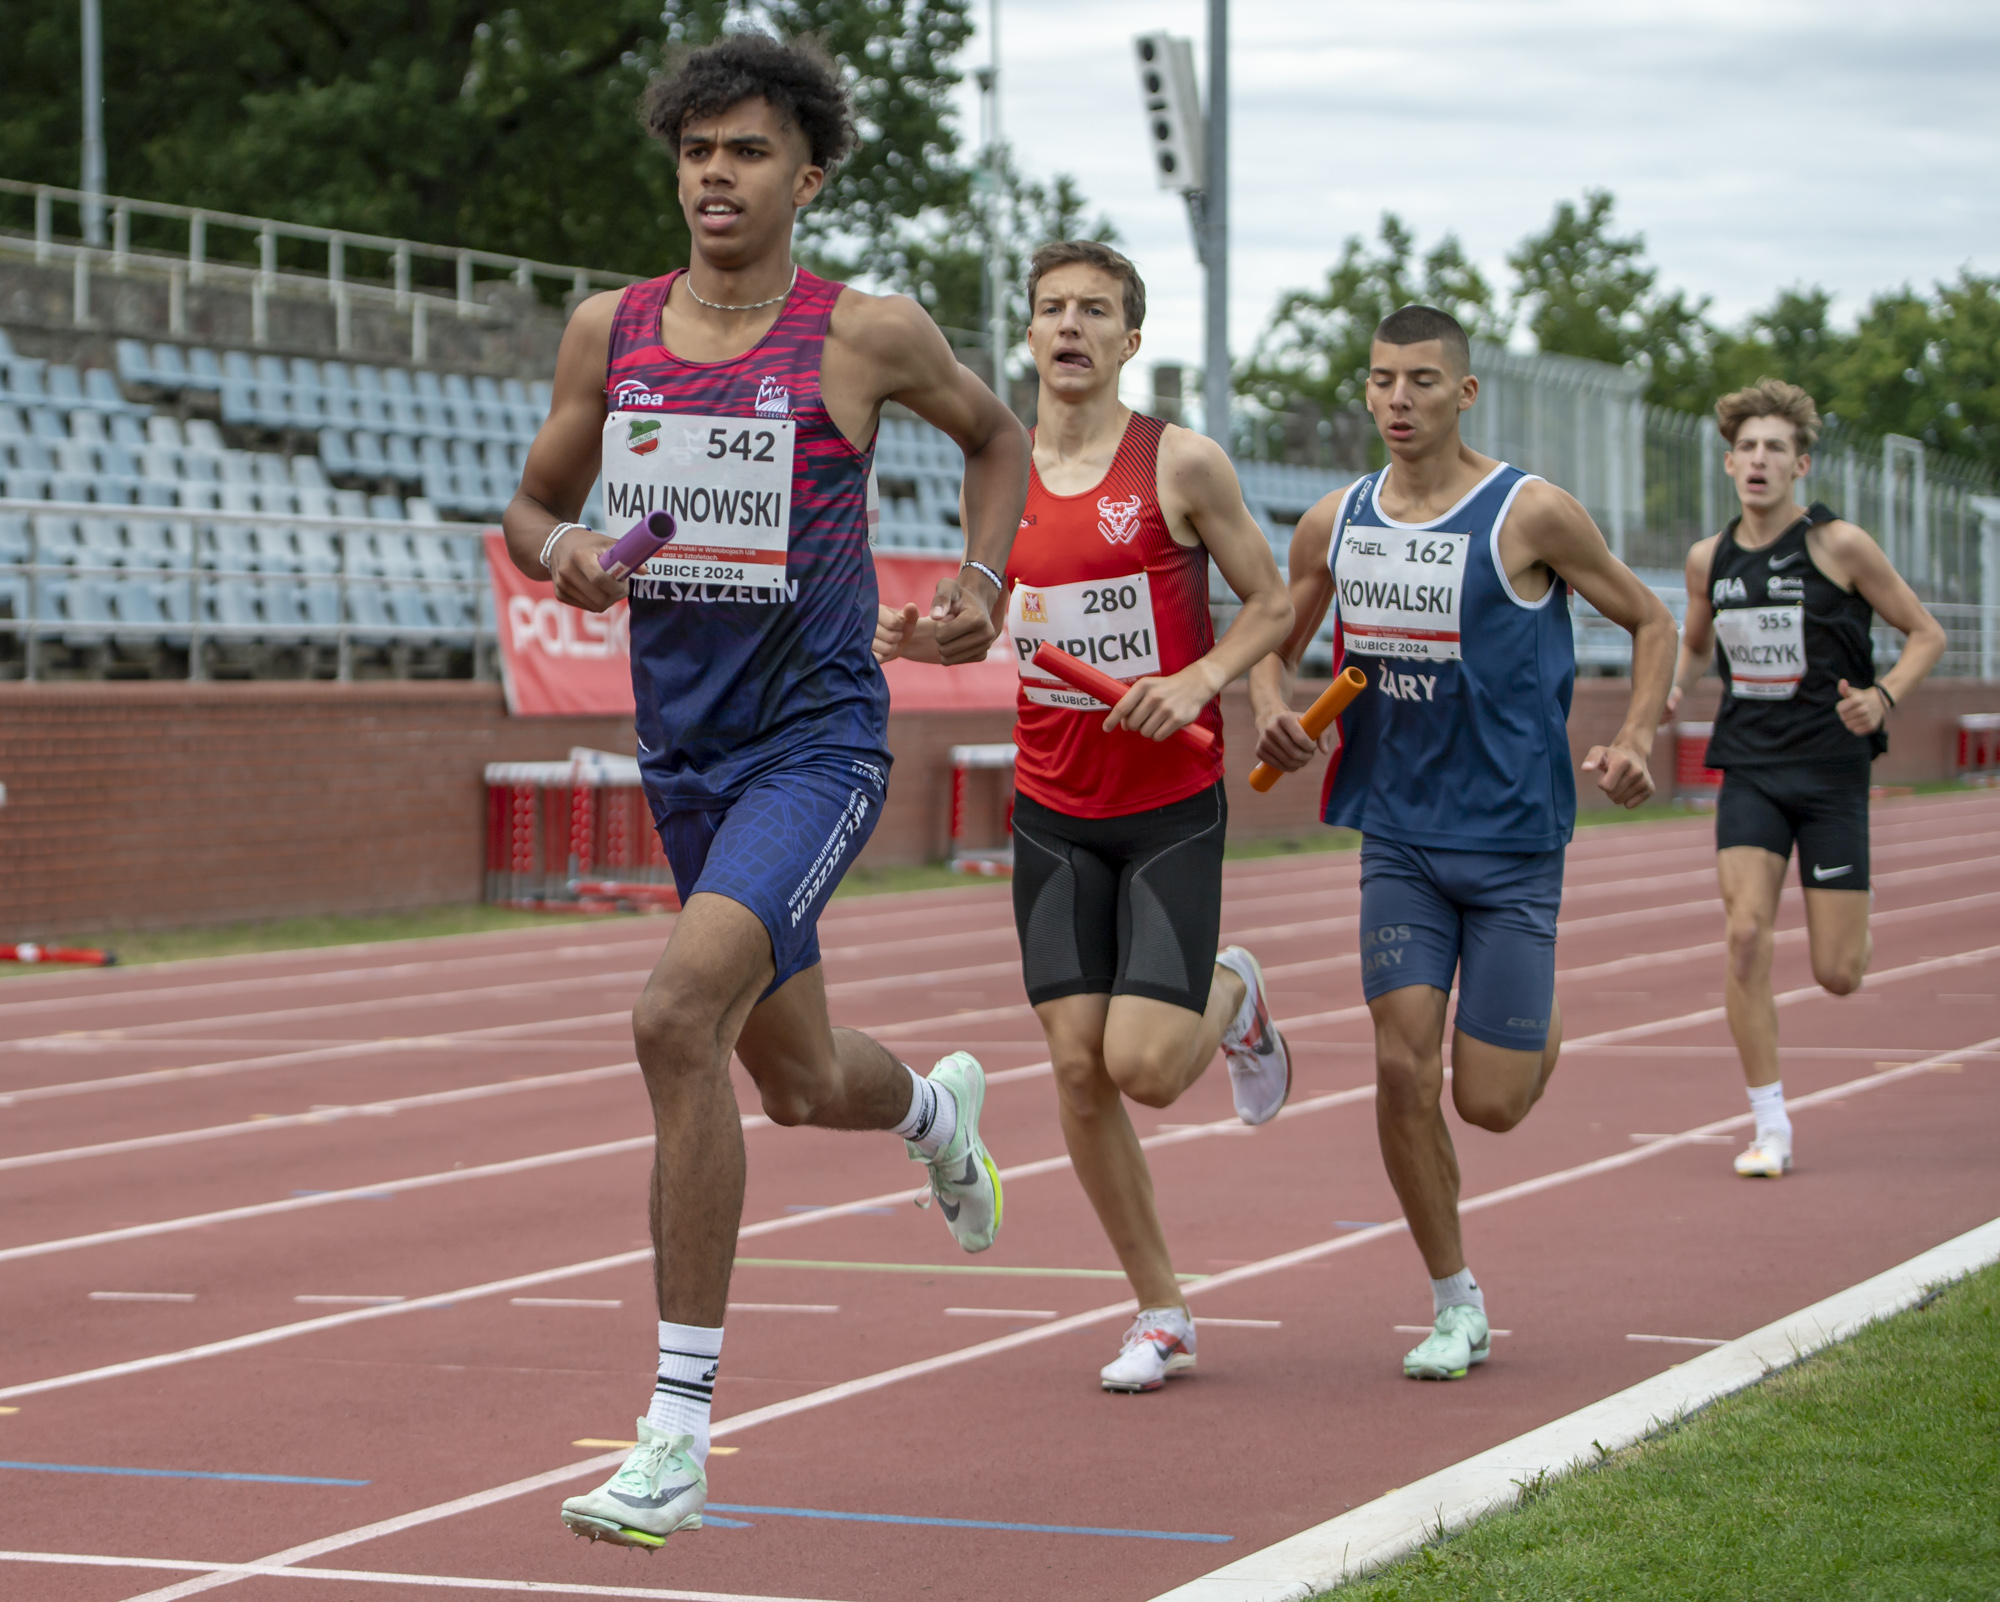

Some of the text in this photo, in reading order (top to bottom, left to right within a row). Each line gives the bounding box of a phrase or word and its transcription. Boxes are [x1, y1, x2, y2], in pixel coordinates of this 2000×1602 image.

[618, 389, 664, 407] Enea
[756, 411, 787, 419] SZCZECIN
[706, 427, 775, 462] 542
[608, 482, 781, 527] MALINOWSKI
[1404, 539, 1454, 565] 162
[704, 567, 744, 581] 2024
[1082, 585, 1137, 614] 280
[1340, 578, 1453, 614] KOWALSKI
[508, 595, 630, 659] POLSK
[1757, 612, 1792, 630] 355
[1354, 639, 1429, 654] SŁUBICE 2024
[1378, 658, 1437, 702] ŻARY
[1050, 693, 1096, 706] SŁUBICE
[790, 833, 847, 928] SZCZECIN
